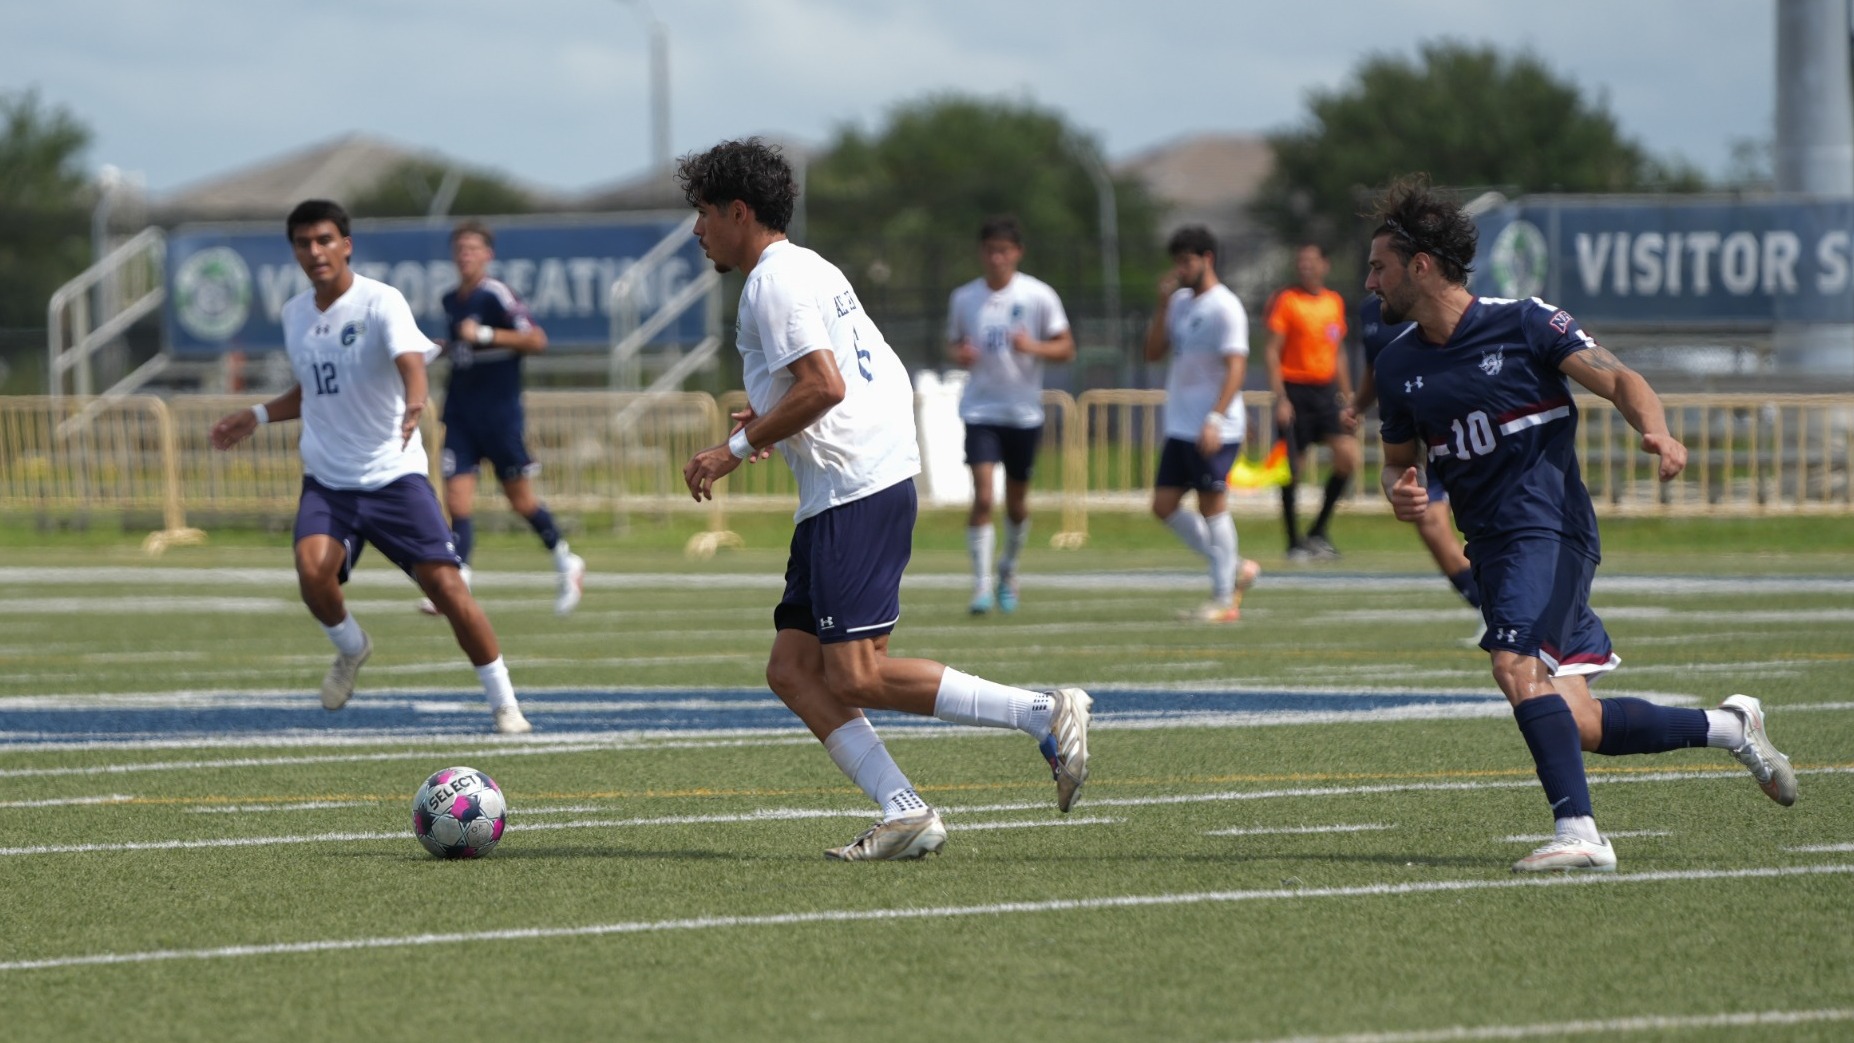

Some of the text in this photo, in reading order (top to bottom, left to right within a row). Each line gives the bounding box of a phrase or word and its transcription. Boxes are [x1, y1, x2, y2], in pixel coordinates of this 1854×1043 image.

[1575, 231, 1854, 296] VISITOR S
[313, 362, 339, 395] 12
[853, 325, 873, 384] 6
[1451, 410, 1496, 460] 10
[429, 775, 477, 811] SELECT
